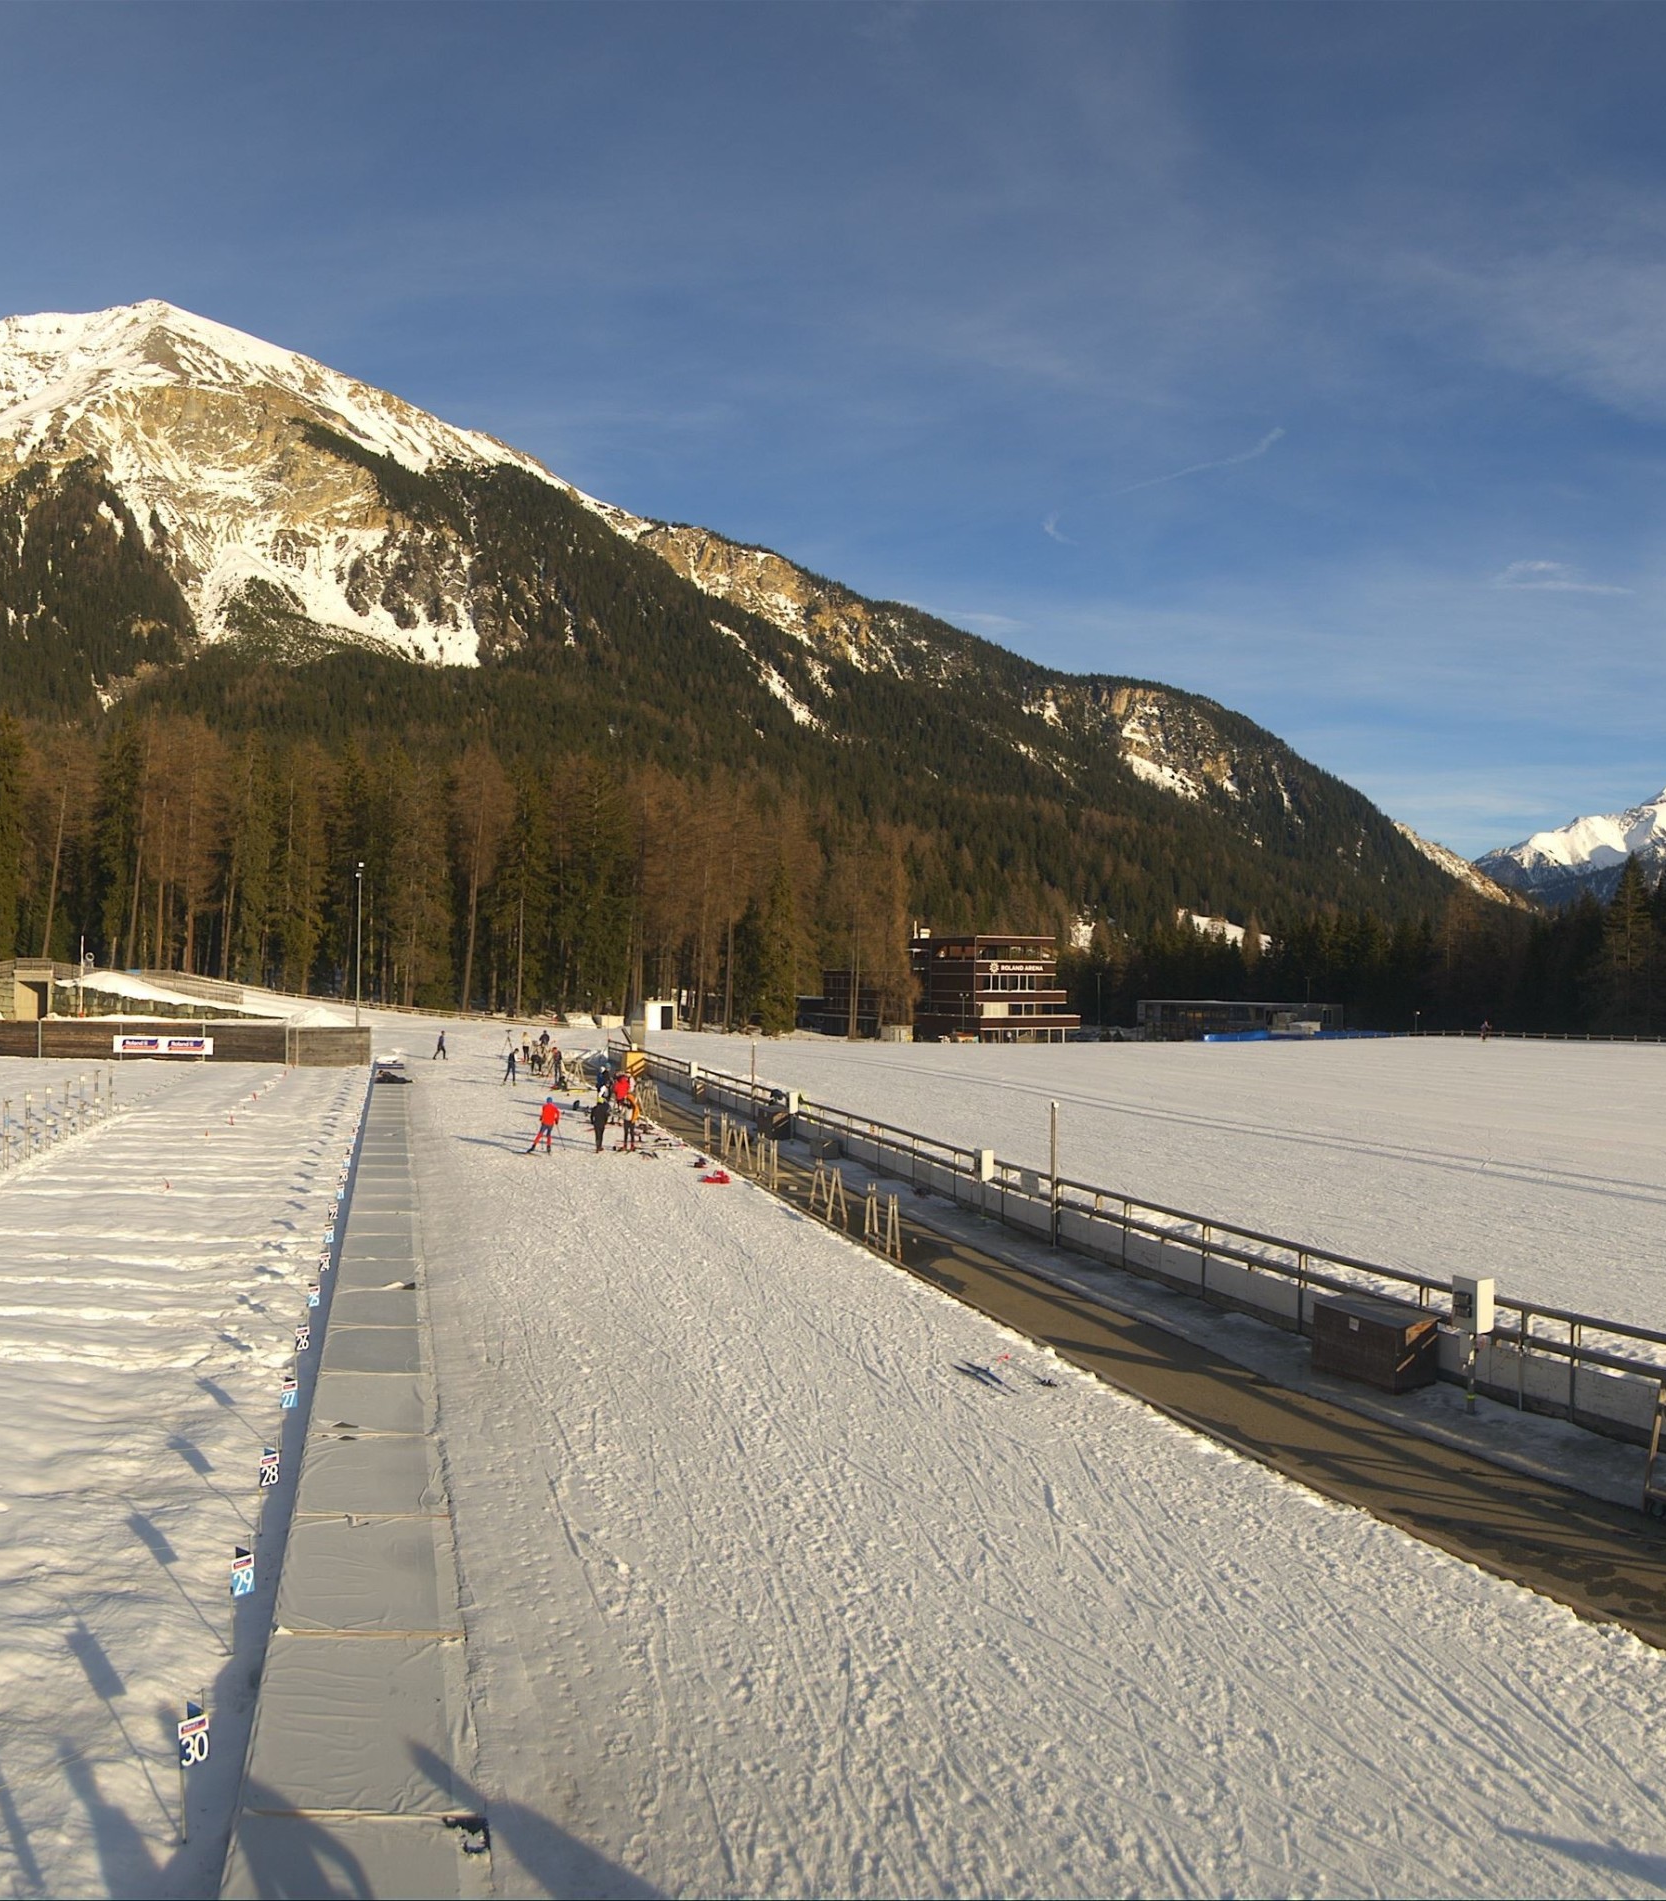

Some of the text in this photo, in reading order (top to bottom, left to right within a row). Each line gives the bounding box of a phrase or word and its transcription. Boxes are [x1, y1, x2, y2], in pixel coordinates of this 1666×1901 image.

[320, 1260, 330, 1271] 24
[309, 1295, 319, 1306] 25
[296, 1336, 309, 1349] 26
[282, 1391, 296, 1408] 27
[261, 1465, 278, 1486] 28
[234, 1569, 254, 1597] 29
[181, 1731, 209, 1766] 30
